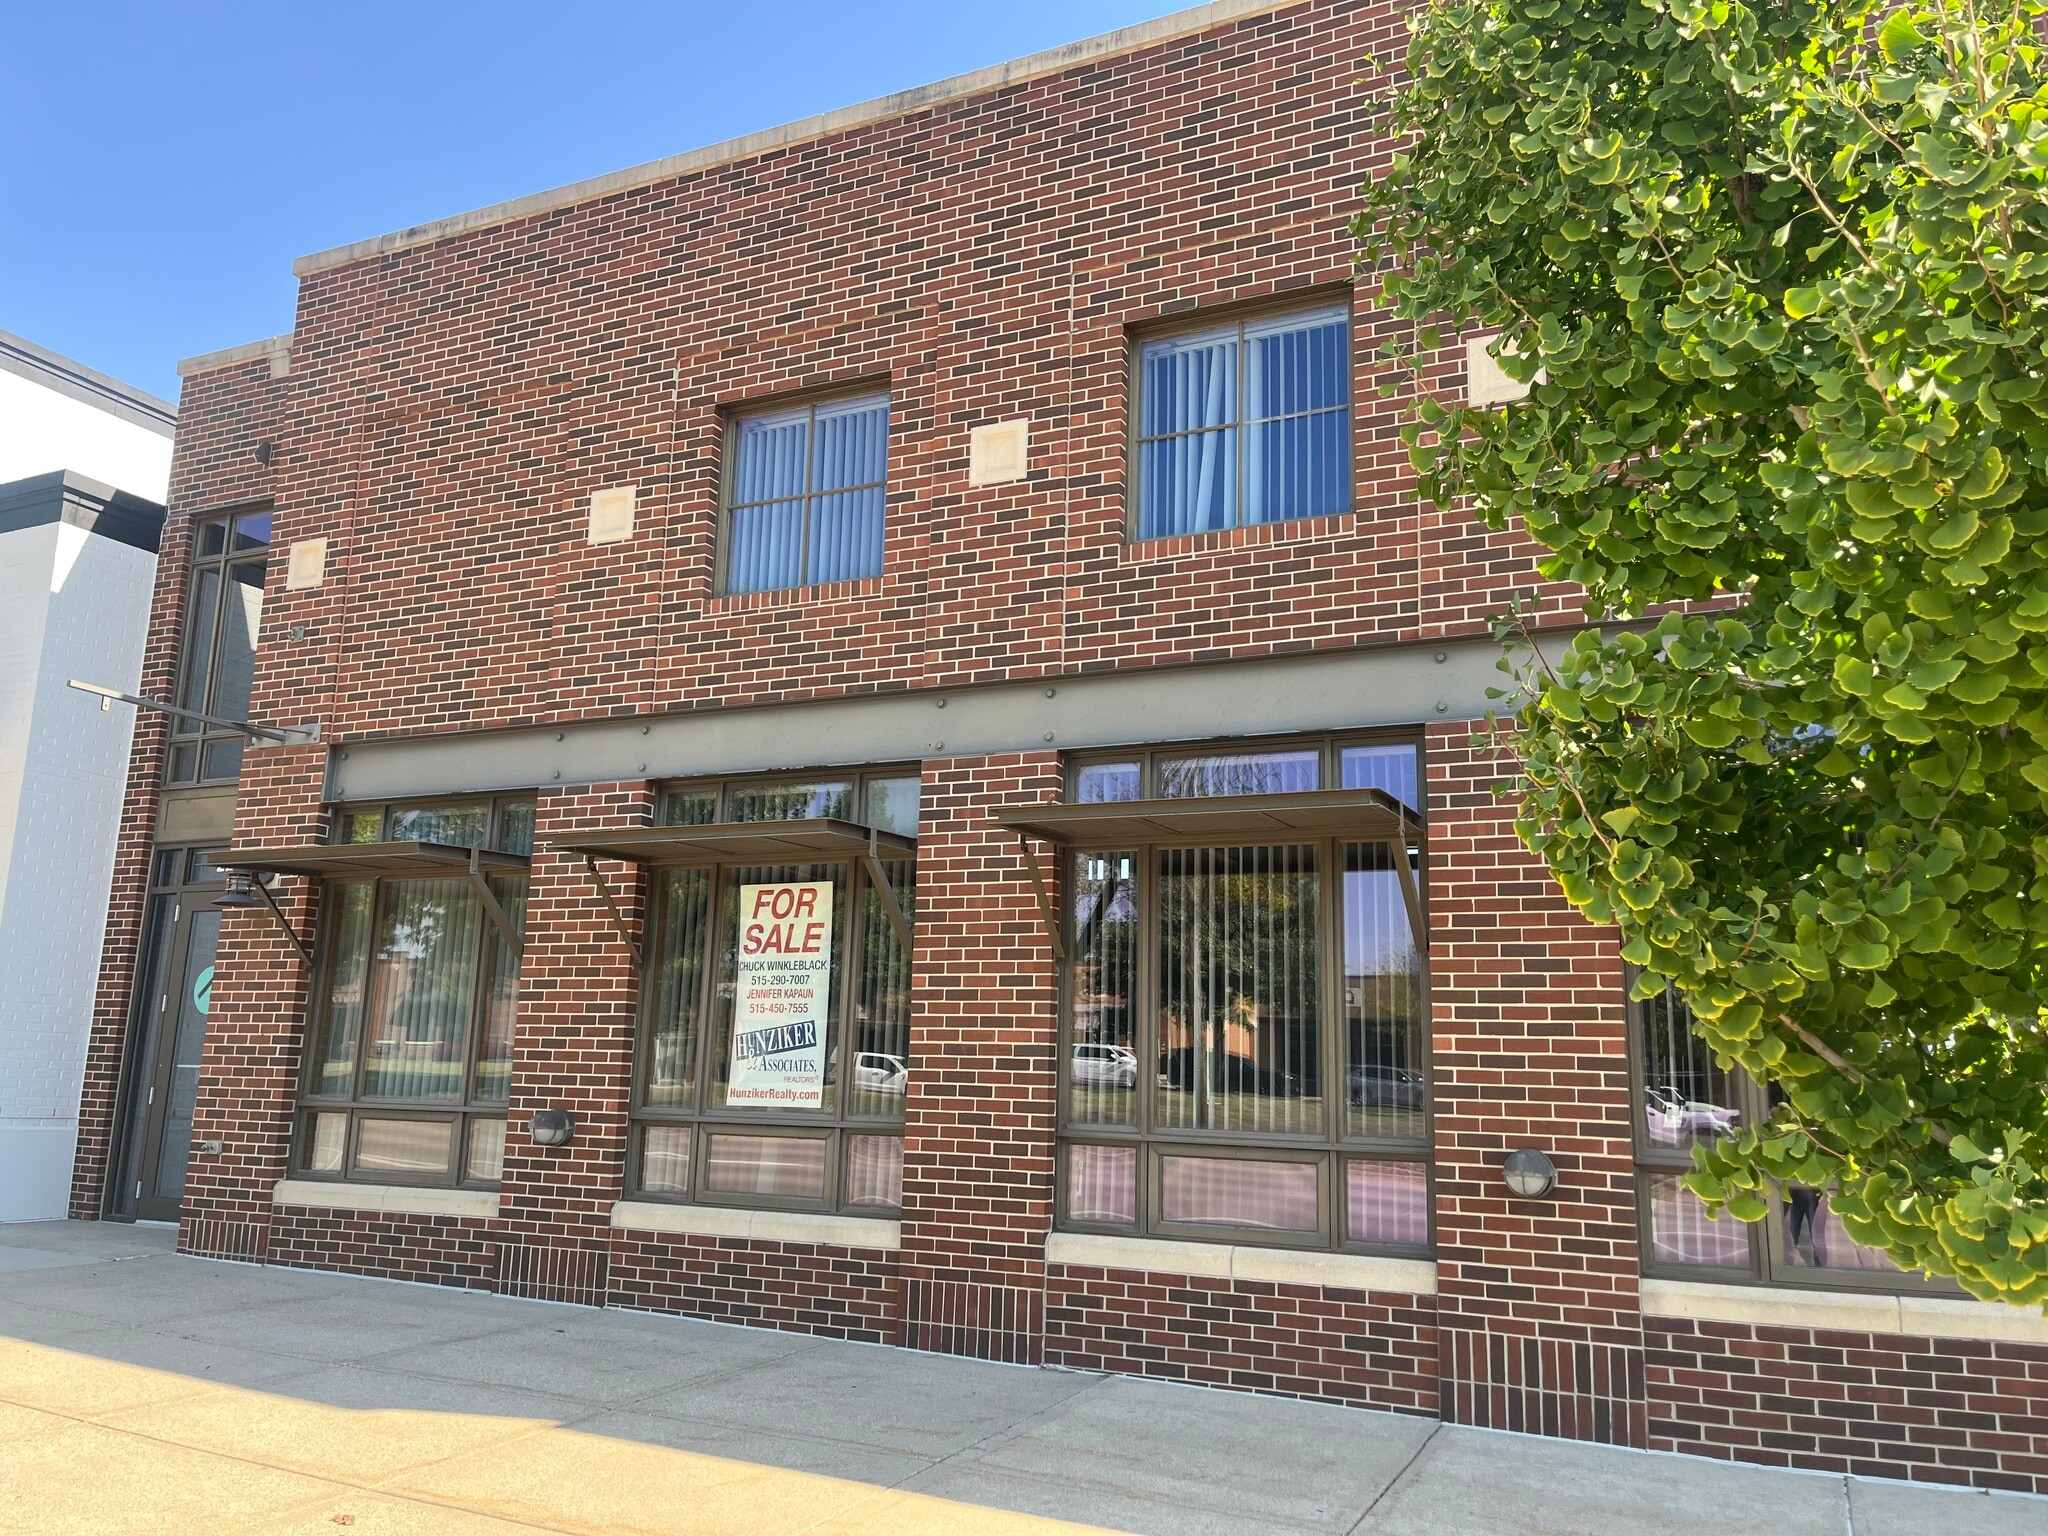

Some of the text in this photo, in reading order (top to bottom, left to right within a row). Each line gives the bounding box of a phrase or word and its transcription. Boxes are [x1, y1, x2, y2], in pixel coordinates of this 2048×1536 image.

[752, 888, 818, 919] FOR
[743, 922, 825, 954] SALE
[739, 960, 828, 971] CHUCK WINKLEBLACK
[751, 975, 810, 985] 515-290-7007
[746, 988, 814, 999] JENNIFER KAPAUN
[749, 1003, 809, 1013] 515-450-7555
[736, 1022, 815, 1057] HUNZIKER
[729, 1087, 819, 1101] HunzikerRealty.com
